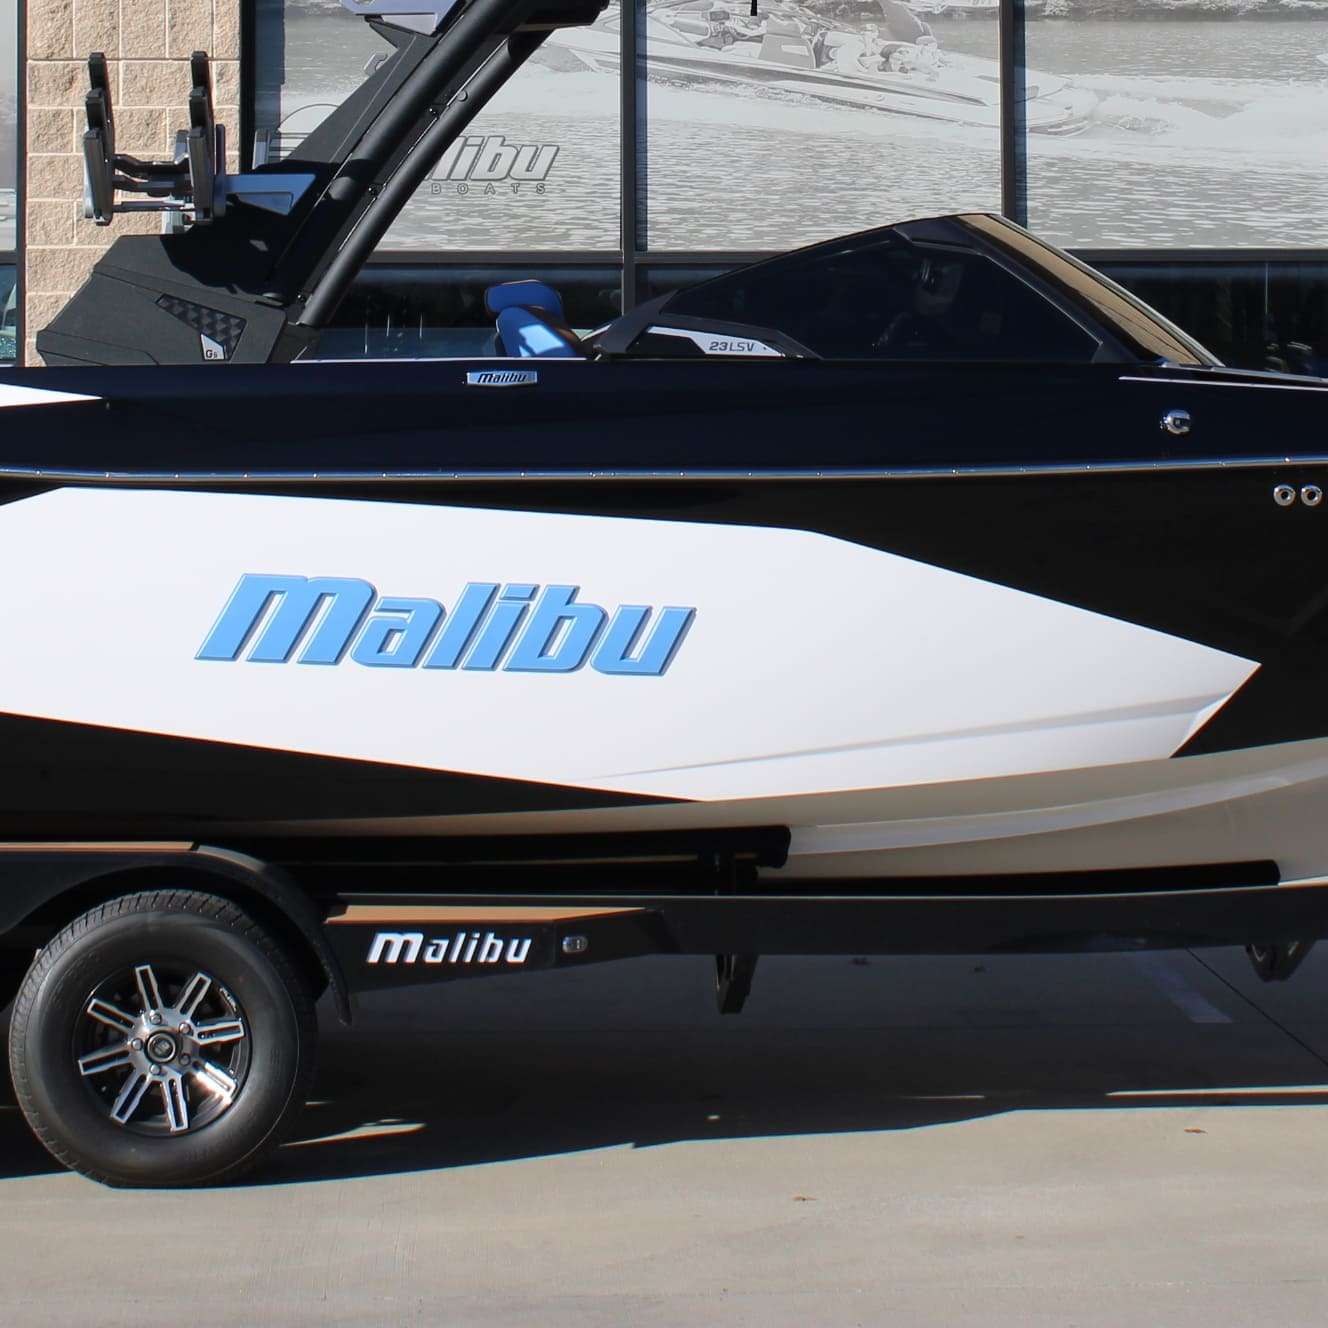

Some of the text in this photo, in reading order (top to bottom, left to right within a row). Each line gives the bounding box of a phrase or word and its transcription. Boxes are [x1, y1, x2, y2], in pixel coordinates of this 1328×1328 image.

[424, 135, 560, 181] libu
[430, 183, 546, 195] BOATS
[709, 341, 755, 352] 23LSV
[477, 372, 527, 384] Malibu
[194, 573, 698, 677] Malibu
[367, 932, 532, 963] Malibu
